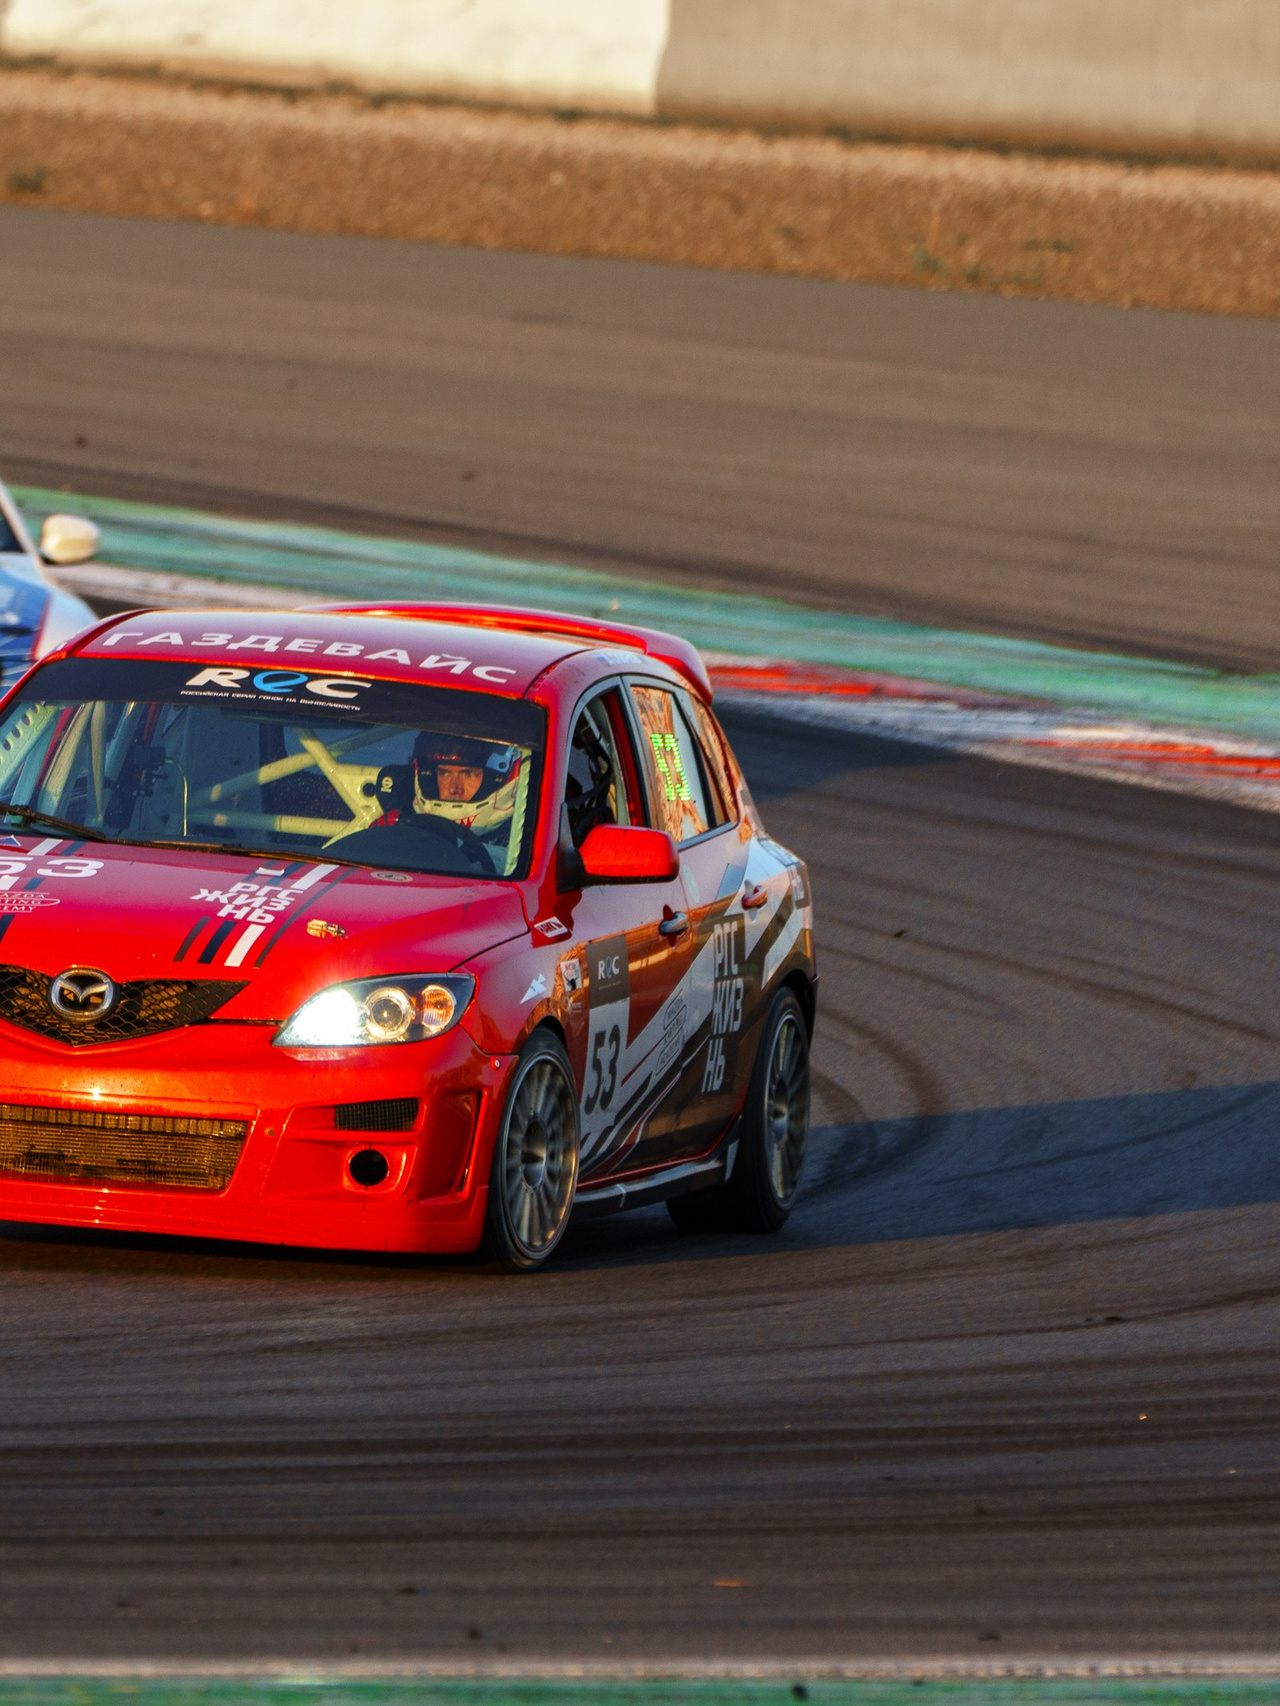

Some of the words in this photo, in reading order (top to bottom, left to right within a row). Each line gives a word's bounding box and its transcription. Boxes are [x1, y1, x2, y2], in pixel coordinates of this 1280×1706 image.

[102, 631, 517, 684] ГАЗДЕВАЙС
[180, 690, 229, 698] РОССИЙСКАЯ
[232, 692, 257, 700] СЕРИЯ
[258, 694, 283, 702] ГОНОК
[299, 698, 361, 711] ВЫНОСЛИВОСТЬ
[650, 733, 692, 801] 53
[189, 888, 292, 912] ЖИЗ
[216, 904, 276, 924] НЬ
[228, 882, 304, 902] РГС
[714, 921, 739, 978] РГС
[712, 977, 744, 1035] ЖИЗ
[584, 1024, 620, 1116] 53
[701, 1038, 726, 1093] НЬ
